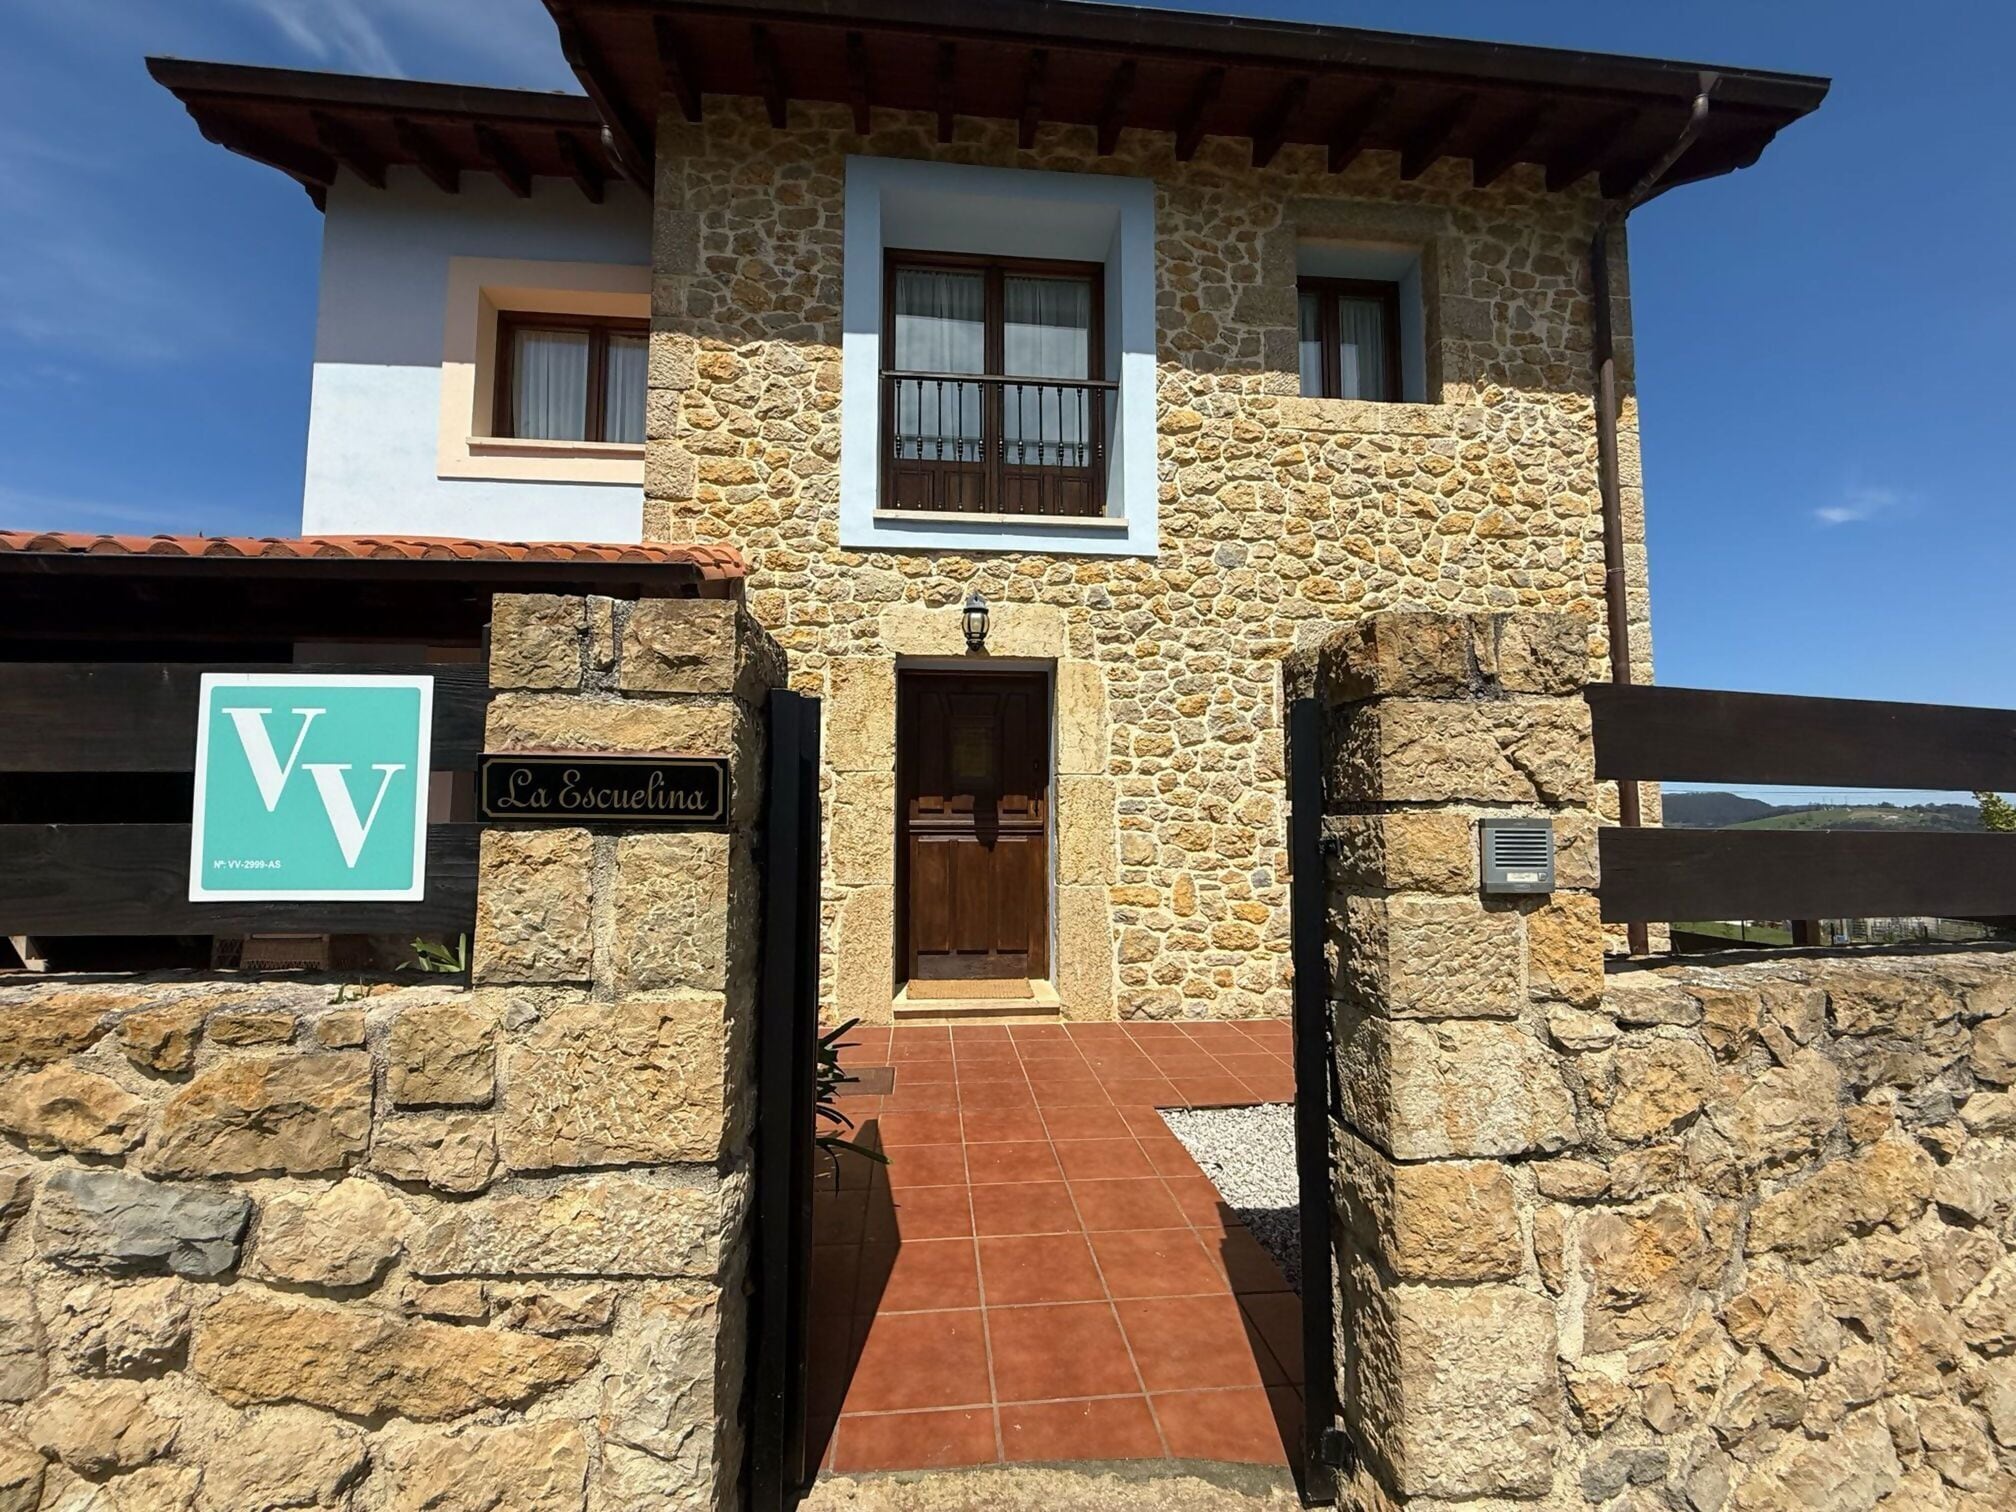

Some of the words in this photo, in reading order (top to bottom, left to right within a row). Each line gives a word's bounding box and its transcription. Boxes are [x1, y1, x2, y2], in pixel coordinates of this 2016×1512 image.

[497, 768, 552, 808] La
[558, 768, 709, 811] Escuelina
[228, 859, 281, 869] VV-2999-AS
